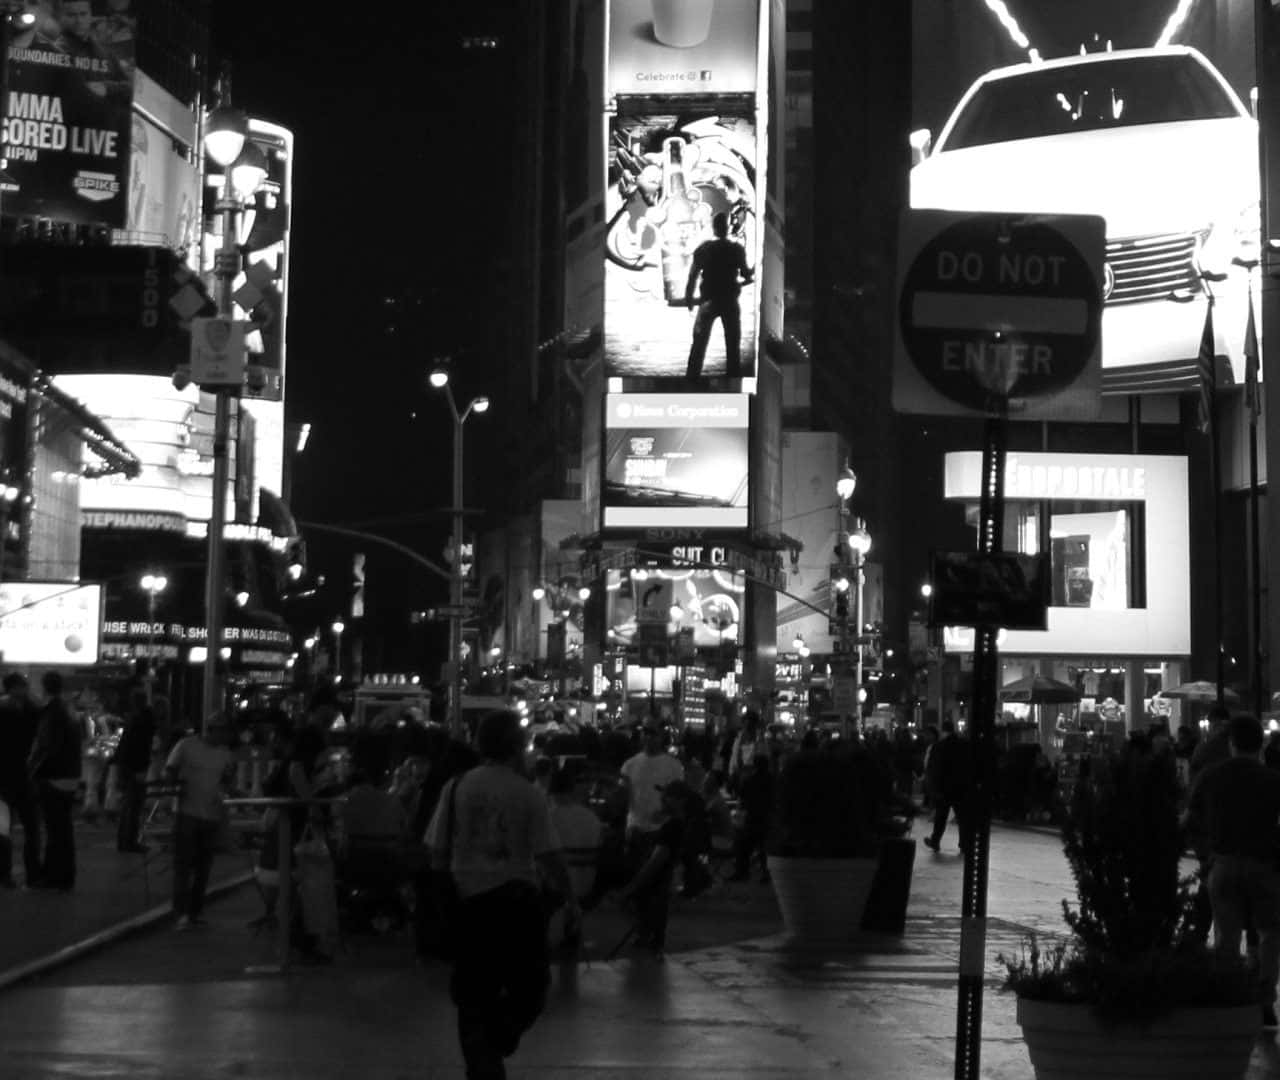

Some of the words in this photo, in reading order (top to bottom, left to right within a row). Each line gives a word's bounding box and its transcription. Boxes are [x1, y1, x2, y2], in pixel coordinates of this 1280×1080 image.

[8, 90, 64, 124] MMA
[71, 125, 119, 159] LIVE
[73, 176, 121, 193] SPIKE
[936, 251, 984, 284] DO
[999, 253, 1067, 288] NOT
[940, 339, 1055, 377] ENTER
[667, 404, 739, 421] Corporation
[647, 527, 707, 539] SONY
[672, 546, 704, 566] SUIT
